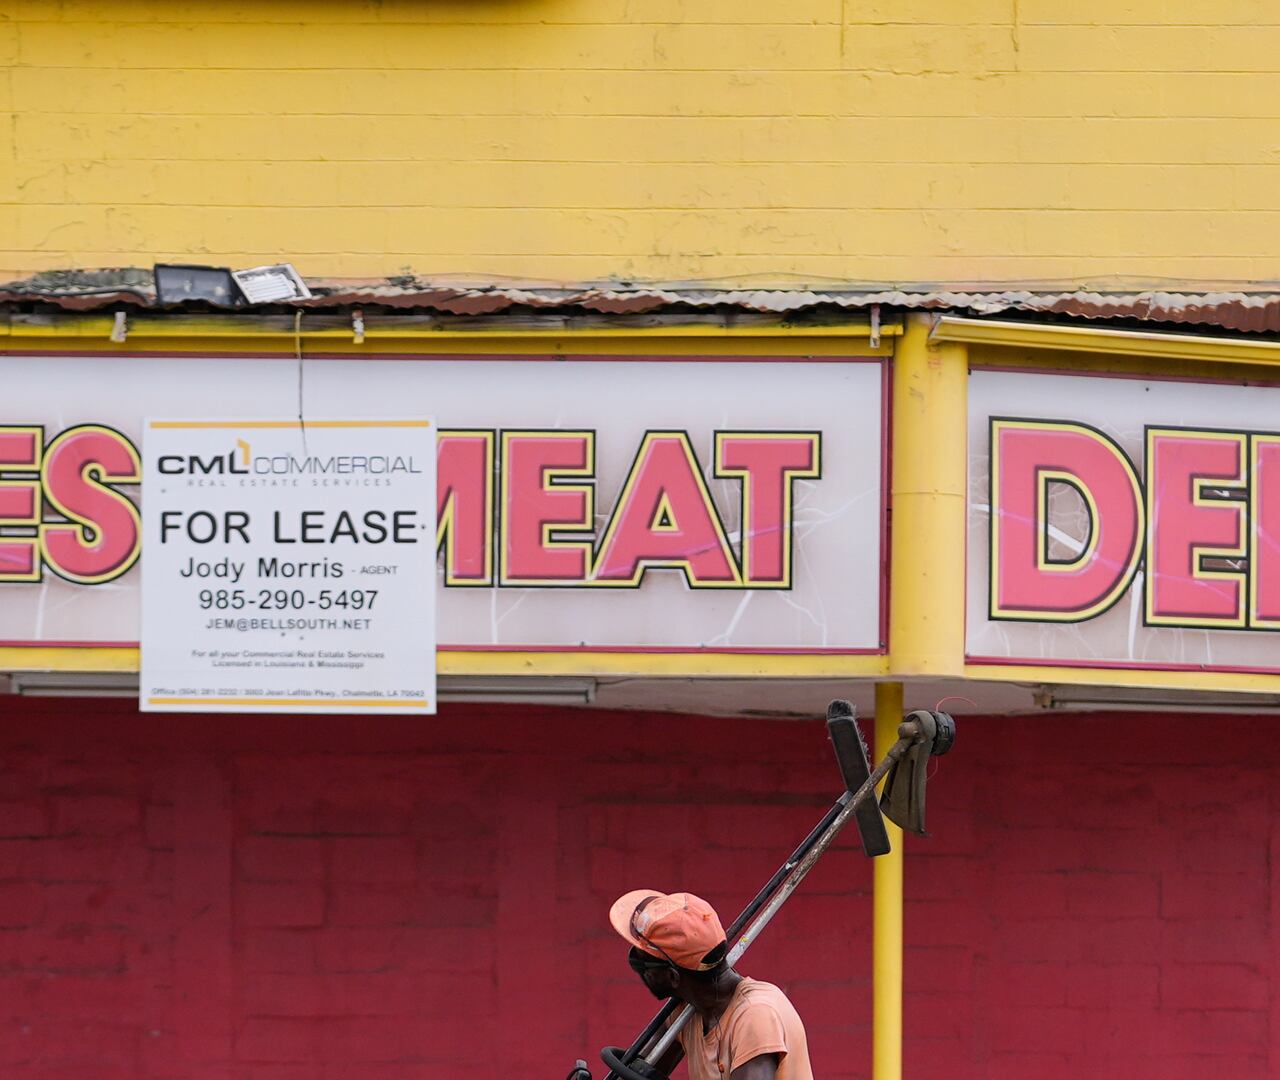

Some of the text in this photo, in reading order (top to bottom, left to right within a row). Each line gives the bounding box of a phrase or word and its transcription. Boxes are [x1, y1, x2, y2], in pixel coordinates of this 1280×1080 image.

[157, 448, 423, 474] CML COMMERCIAL
[187, 478, 392, 488] REAL ESTATE SERVICES
[160, 510, 418, 544] FOR LEASE
[180, 557, 245, 583] Jody
[257, 557, 344, 578] Morris
[360, 565, 398, 575] AGENT
[199, 589, 379, 610] 985-290-5497
[205, 618, 372, 630] JEM@BELLSOUTH.NET
[191, 650, 206, 658] For
[221, 650, 239, 660] your
[243, 650, 294, 659] Commercial
[297, 651, 314, 659] Real
[318, 651, 345, 659] Estate
[348, 651, 385, 660] Services
